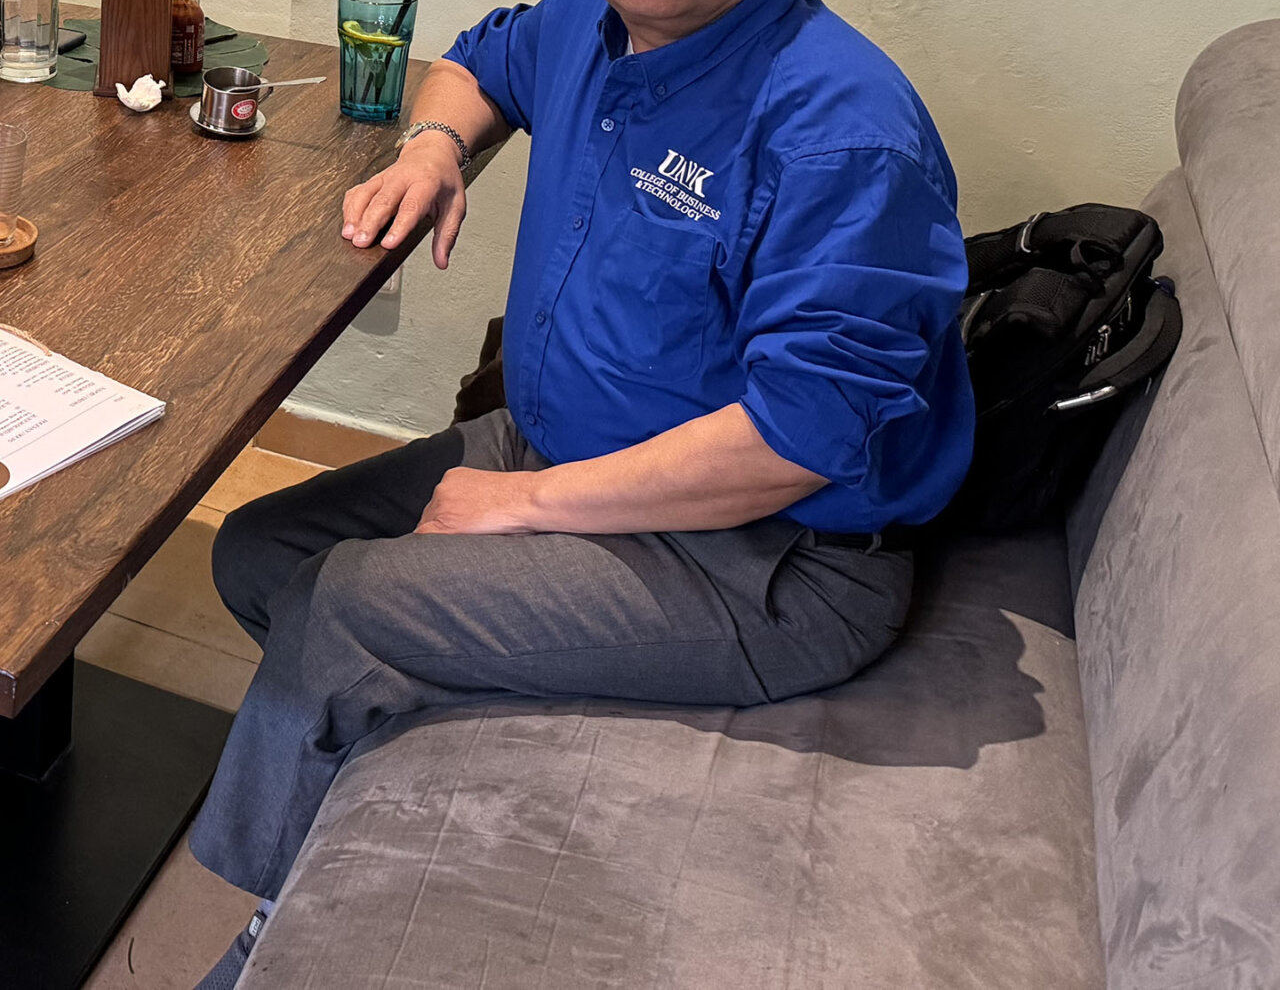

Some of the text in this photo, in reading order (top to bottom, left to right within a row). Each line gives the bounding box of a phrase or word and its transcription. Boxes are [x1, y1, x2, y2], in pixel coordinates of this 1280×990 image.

[630, 167, 722, 220] COLLEGE OF BUSINESS
[658, 149, 714, 198] UNK
